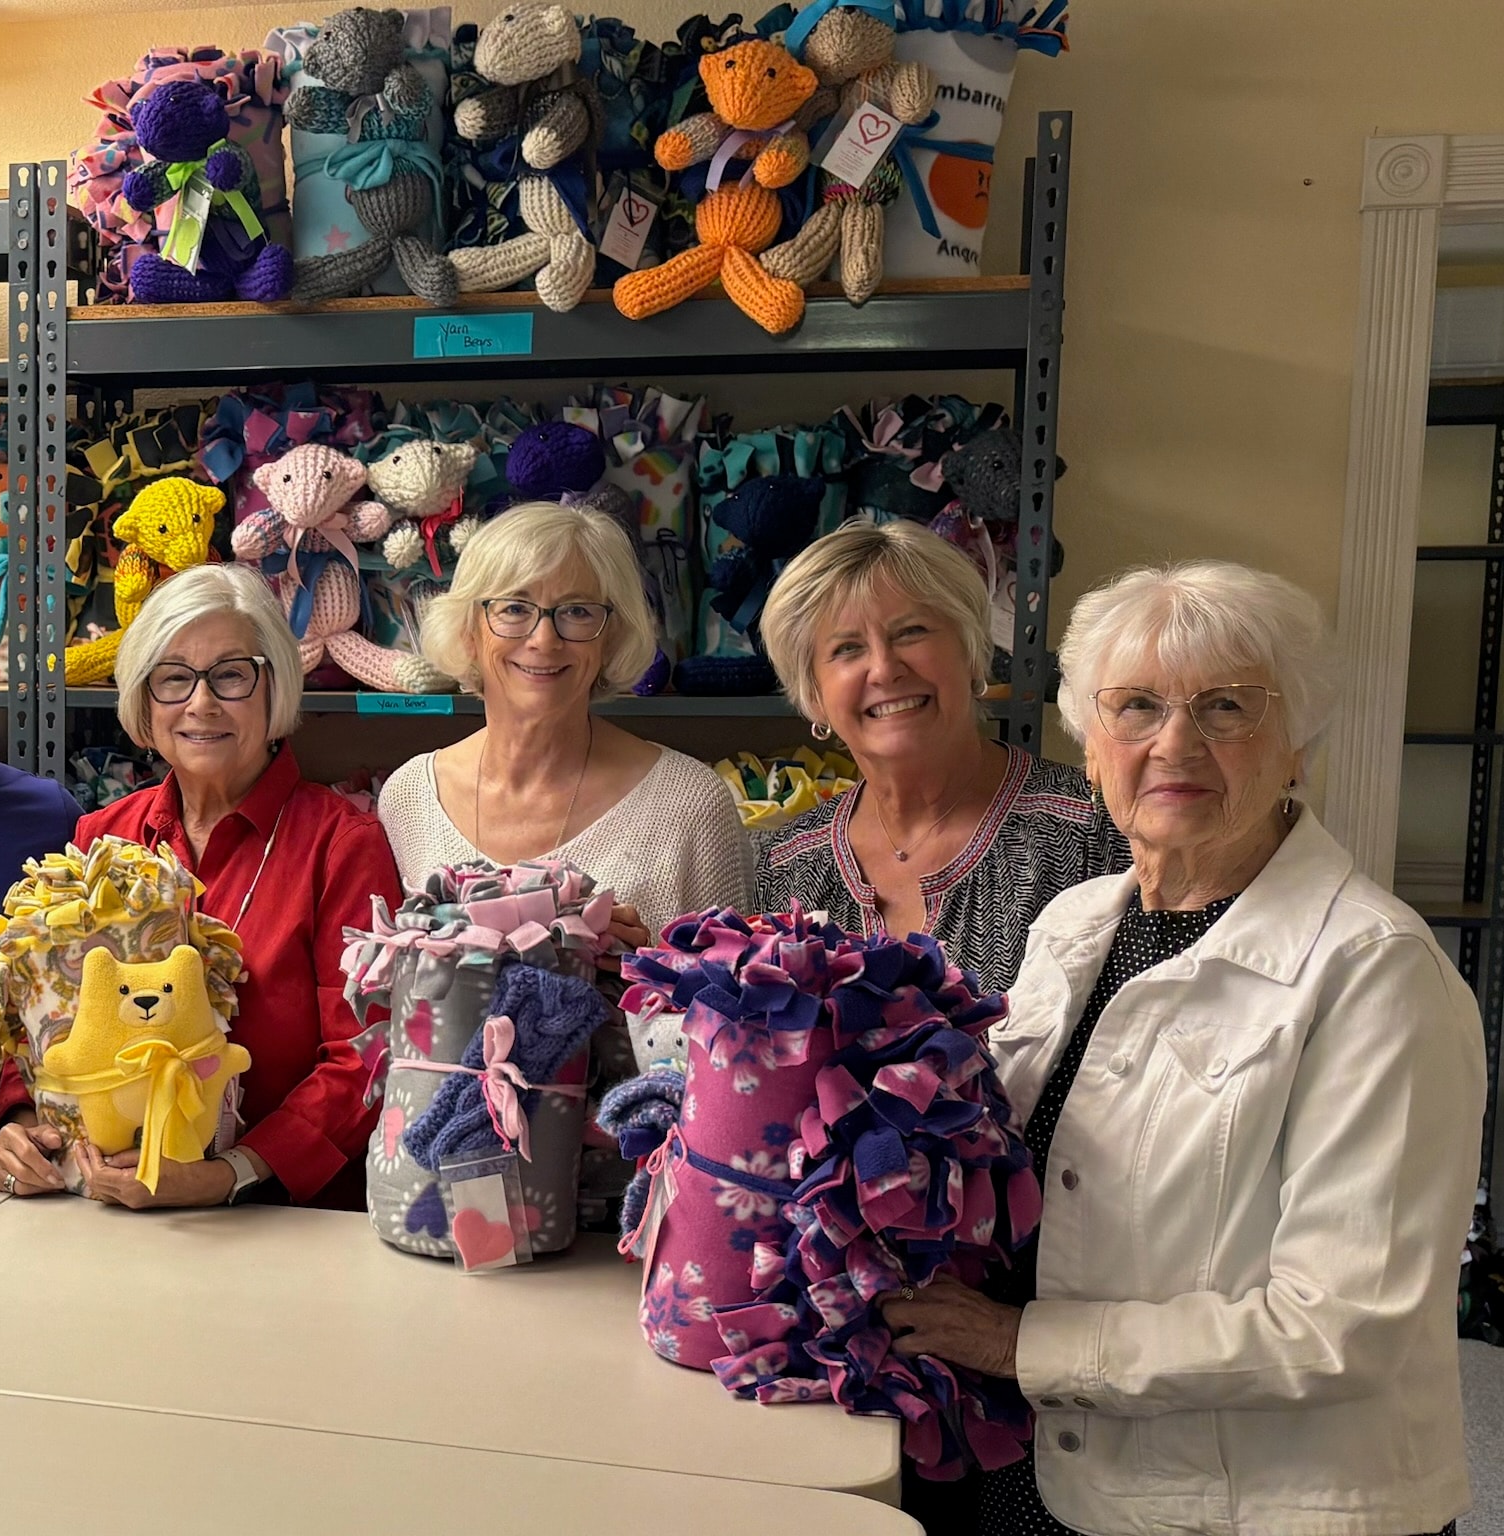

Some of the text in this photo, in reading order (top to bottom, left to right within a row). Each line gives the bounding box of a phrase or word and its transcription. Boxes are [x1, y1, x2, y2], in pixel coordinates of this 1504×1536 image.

[439, 321, 469, 342] Yarn
[464, 336, 494, 348] Bears
[377, 698, 427, 710] Yarn Bears
